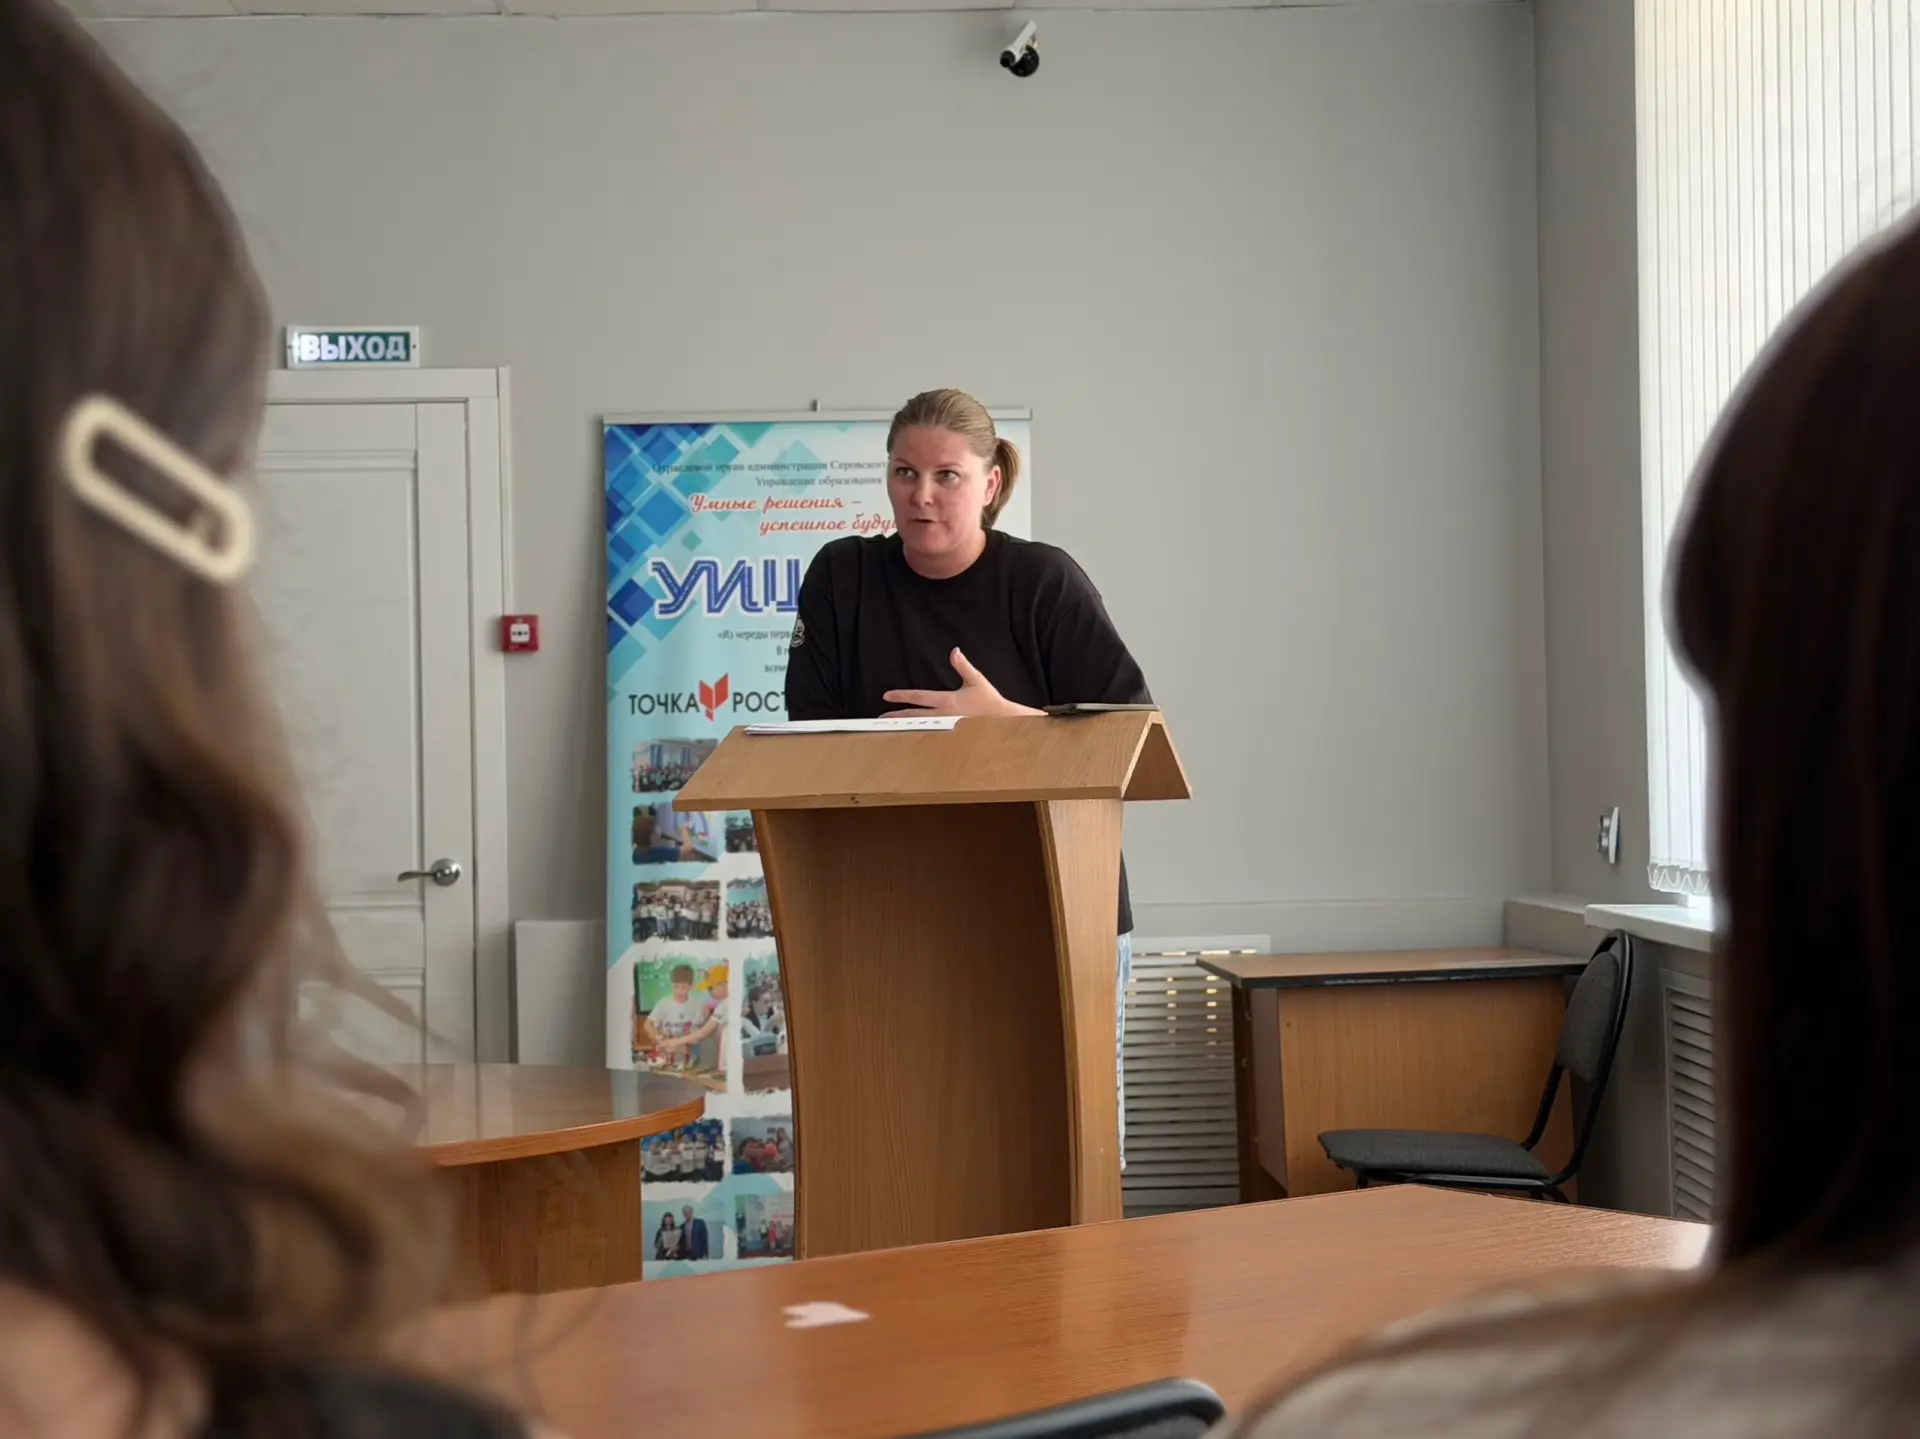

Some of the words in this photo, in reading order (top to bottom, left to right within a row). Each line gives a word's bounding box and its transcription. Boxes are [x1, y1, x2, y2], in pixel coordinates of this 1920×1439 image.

[299, 333, 407, 362] ВЫХОД
[747, 461, 828, 473] администрации
[829, 459, 886, 472] Серовског
[755, 476, 816, 489] Управление
[817, 475, 883, 488] образования
[689, 494, 757, 514] Умные
[762, 494, 846, 516] решения
[759, 517, 847, 537] успешное
[769, 629, 792, 642] перв
[628, 691, 701, 716] ТОЧКА
[732, 690, 789, 713] РОСТ
